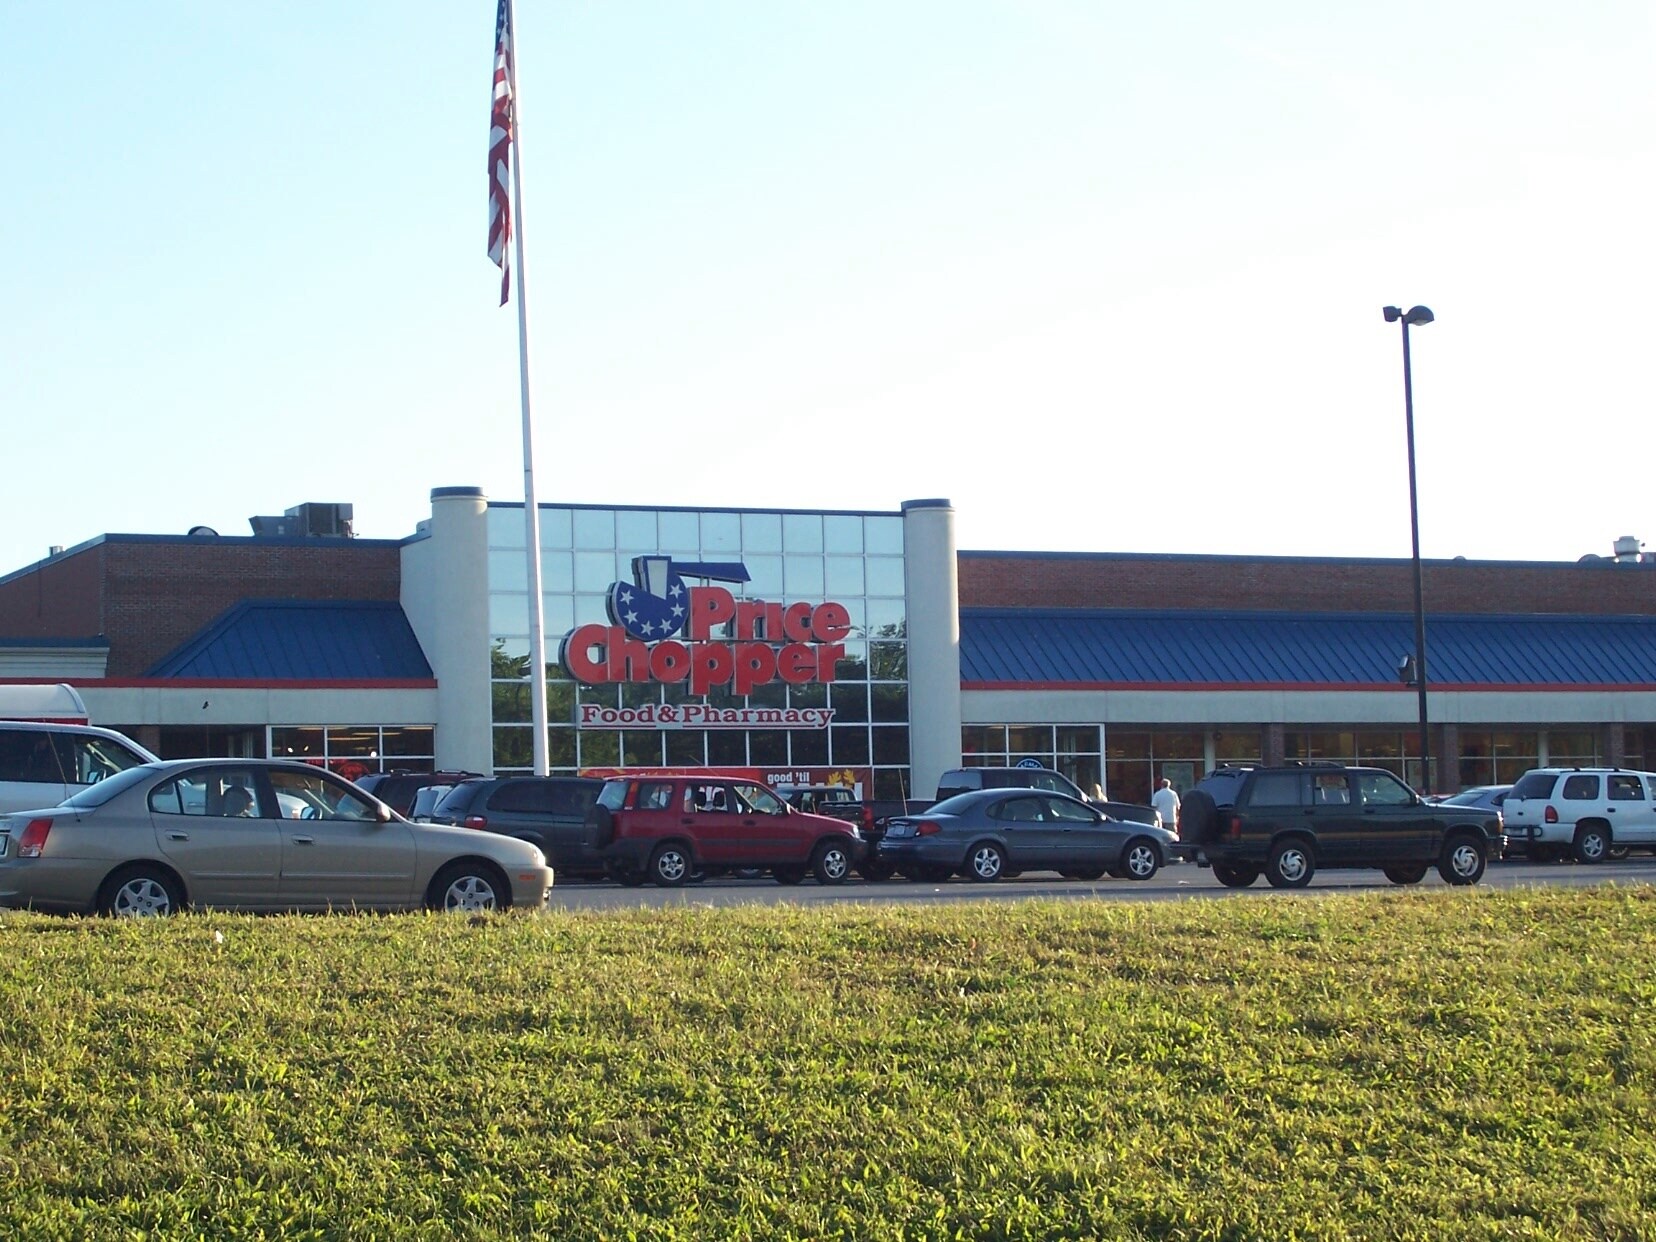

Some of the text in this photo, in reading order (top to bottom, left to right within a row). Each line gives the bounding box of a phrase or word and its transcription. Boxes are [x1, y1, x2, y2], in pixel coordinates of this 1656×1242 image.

[688, 586, 851, 643] Price
[564, 622, 846, 696] Chopper
[767, 772, 792, 784] good
